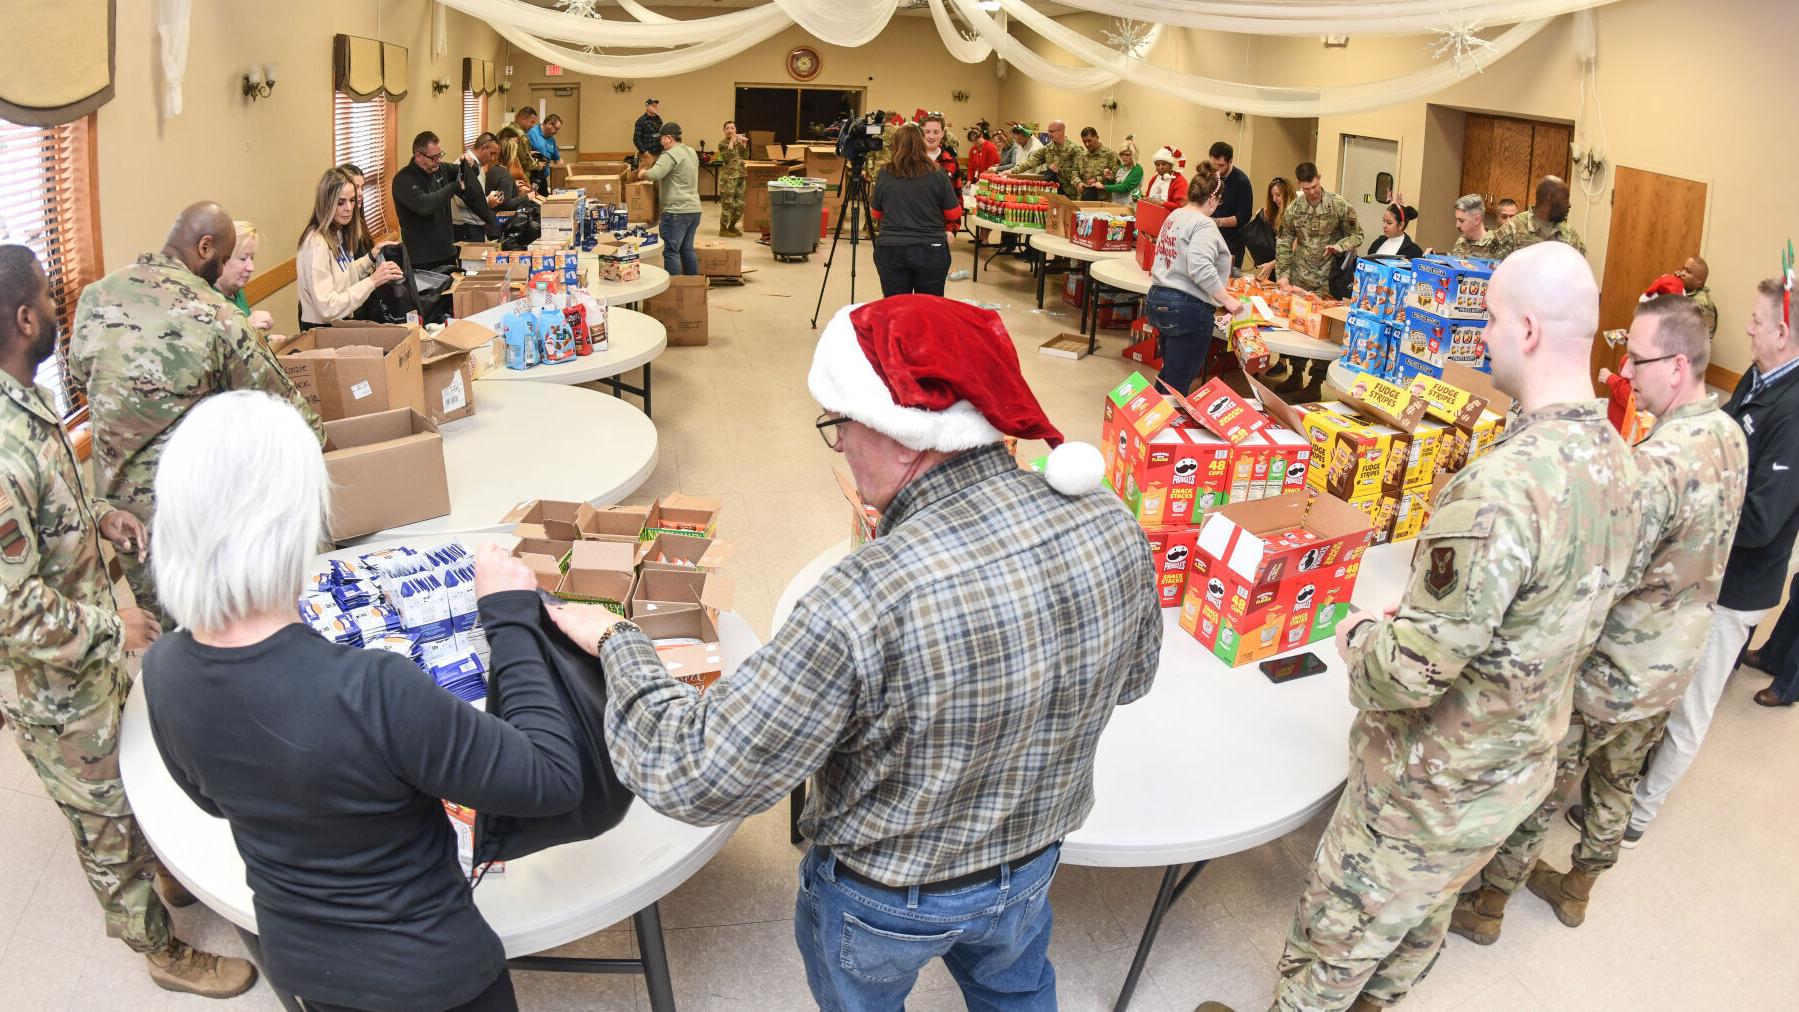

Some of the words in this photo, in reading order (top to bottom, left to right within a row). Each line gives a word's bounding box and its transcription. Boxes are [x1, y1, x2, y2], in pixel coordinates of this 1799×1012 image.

[1357, 262, 1365, 271] 42
[1393, 272, 1401, 280] 42
[1348, 316, 1356, 325] 42
[1393, 330, 1401, 338] 42
[1374, 383, 1400, 400] FUDGE
[1432, 383, 1459, 398] FUDGE
[1369, 390, 1397, 408] STRIPES
[1428, 389, 1456, 405] STRIPES
[1312, 443, 1326, 456] UDGE
[1208, 461, 1226, 471] 48
[1362, 463, 1381, 473] FUDGE
[1172, 474, 1196, 485] PRINGLES
[1360, 469, 1380, 479] STRIPES
[1164, 560, 1187, 571] PRINGLES
[1345, 562, 1359, 574] 48
[1231, 594, 1246, 611] 48
